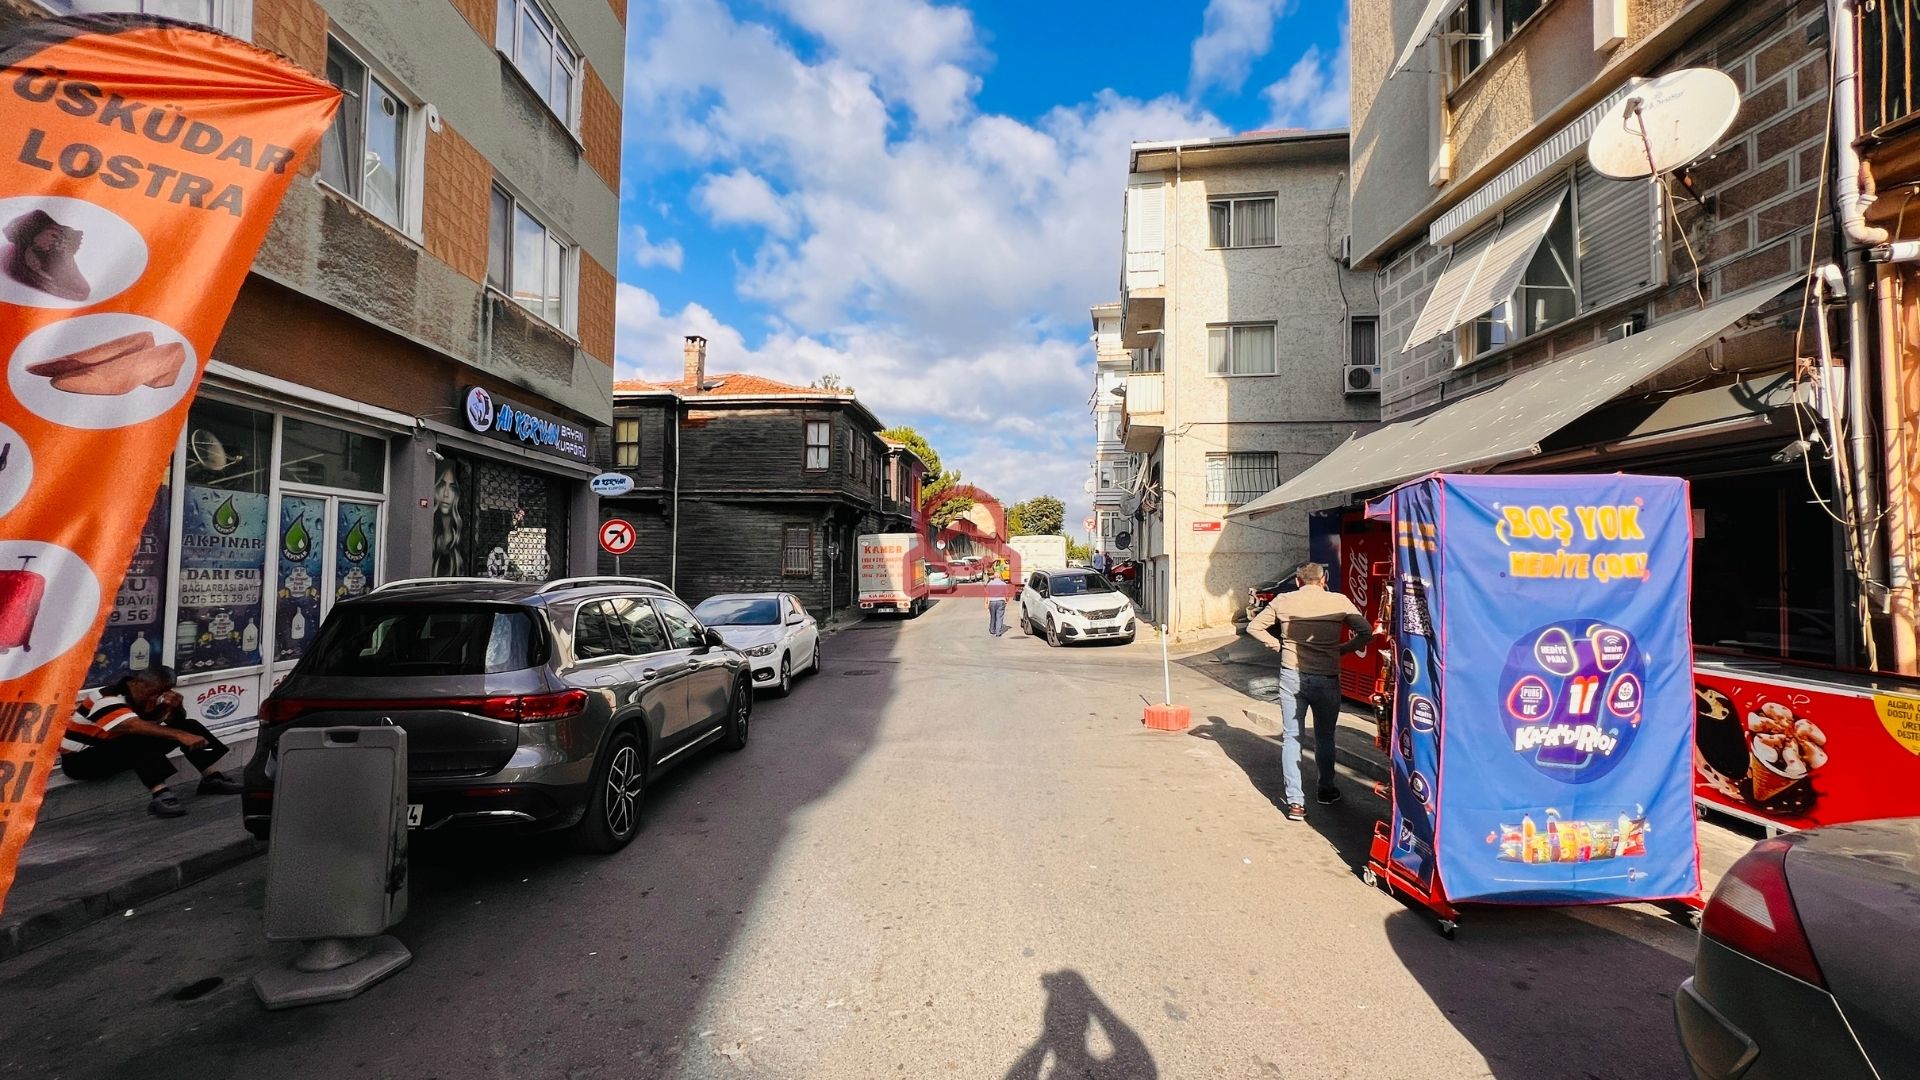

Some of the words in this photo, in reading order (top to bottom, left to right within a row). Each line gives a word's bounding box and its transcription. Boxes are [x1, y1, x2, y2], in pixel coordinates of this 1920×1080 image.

[12, 66, 296, 175] ÜSKÜDAR
[17, 128, 244, 218] LOSTRA
[561, 425, 584, 442] BAYAN
[1502, 505, 1573, 547] BOŞ
[1574, 505, 1645, 541] YOK
[182, 534, 261, 549] AKPINAR
[1508, 548, 1591, 579] HEDİYE
[187, 569, 230, 580] DARI
[234, 569, 255, 580] SU
[182, 595, 207, 604] 0216
[210, 594, 228, 603] 553
[231, 594, 243, 603] 39
[246, 593, 257, 602] 56
[127, 609, 149, 621] 56
[1545, 654, 1568, 664] PARA
[196, 684, 246, 704] SARAY
[1523, 704, 1538, 715] UC
[1887, 700, 1914, 711] ALGIDA
[1887, 709, 1912, 720] DOSTU
